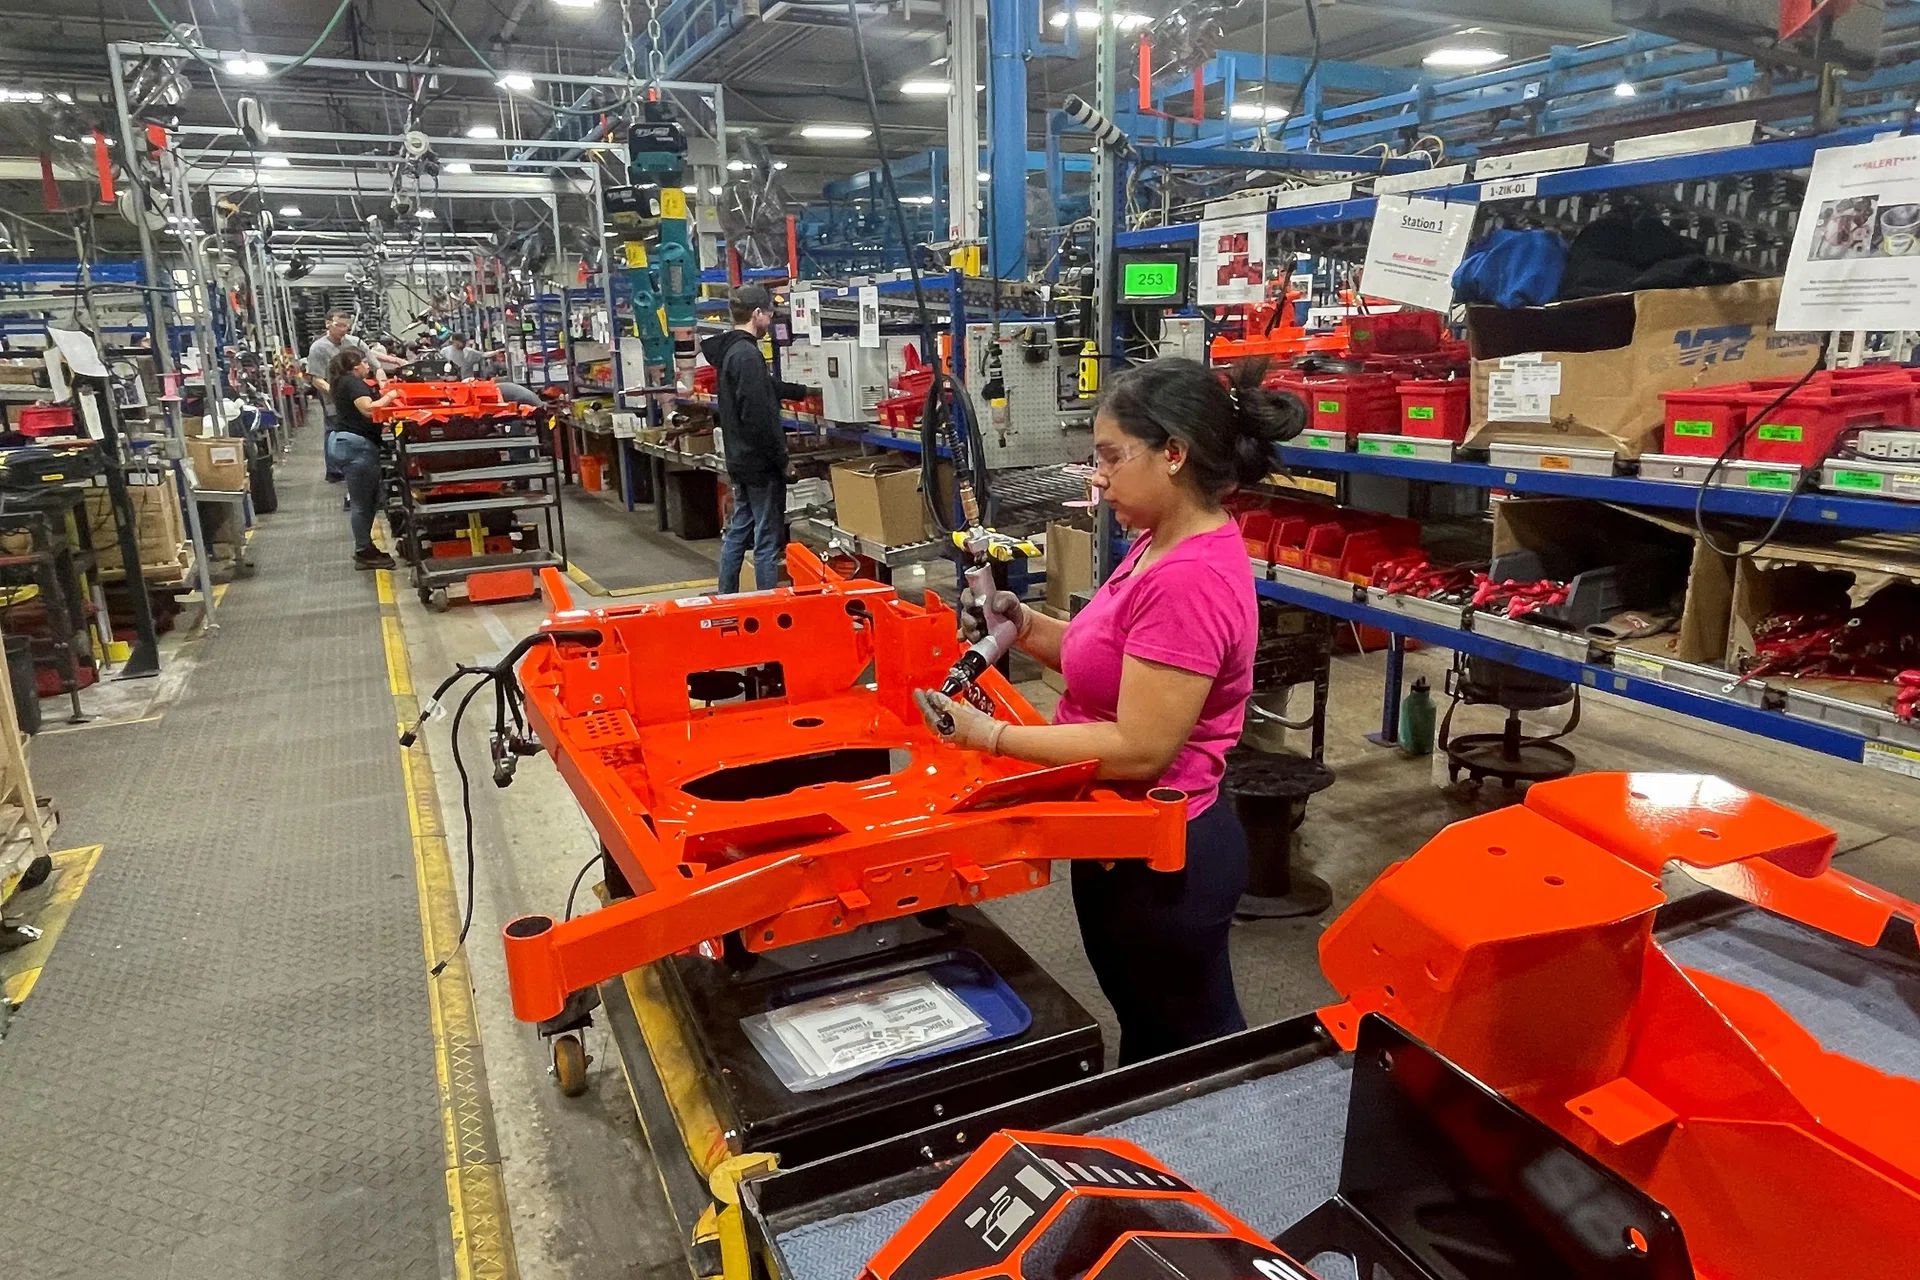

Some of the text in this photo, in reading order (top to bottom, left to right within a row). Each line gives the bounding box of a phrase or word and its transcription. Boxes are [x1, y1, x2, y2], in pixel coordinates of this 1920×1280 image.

[1401, 214, 1444, 231] Station 1
[1138, 273, 1164, 286] 253
